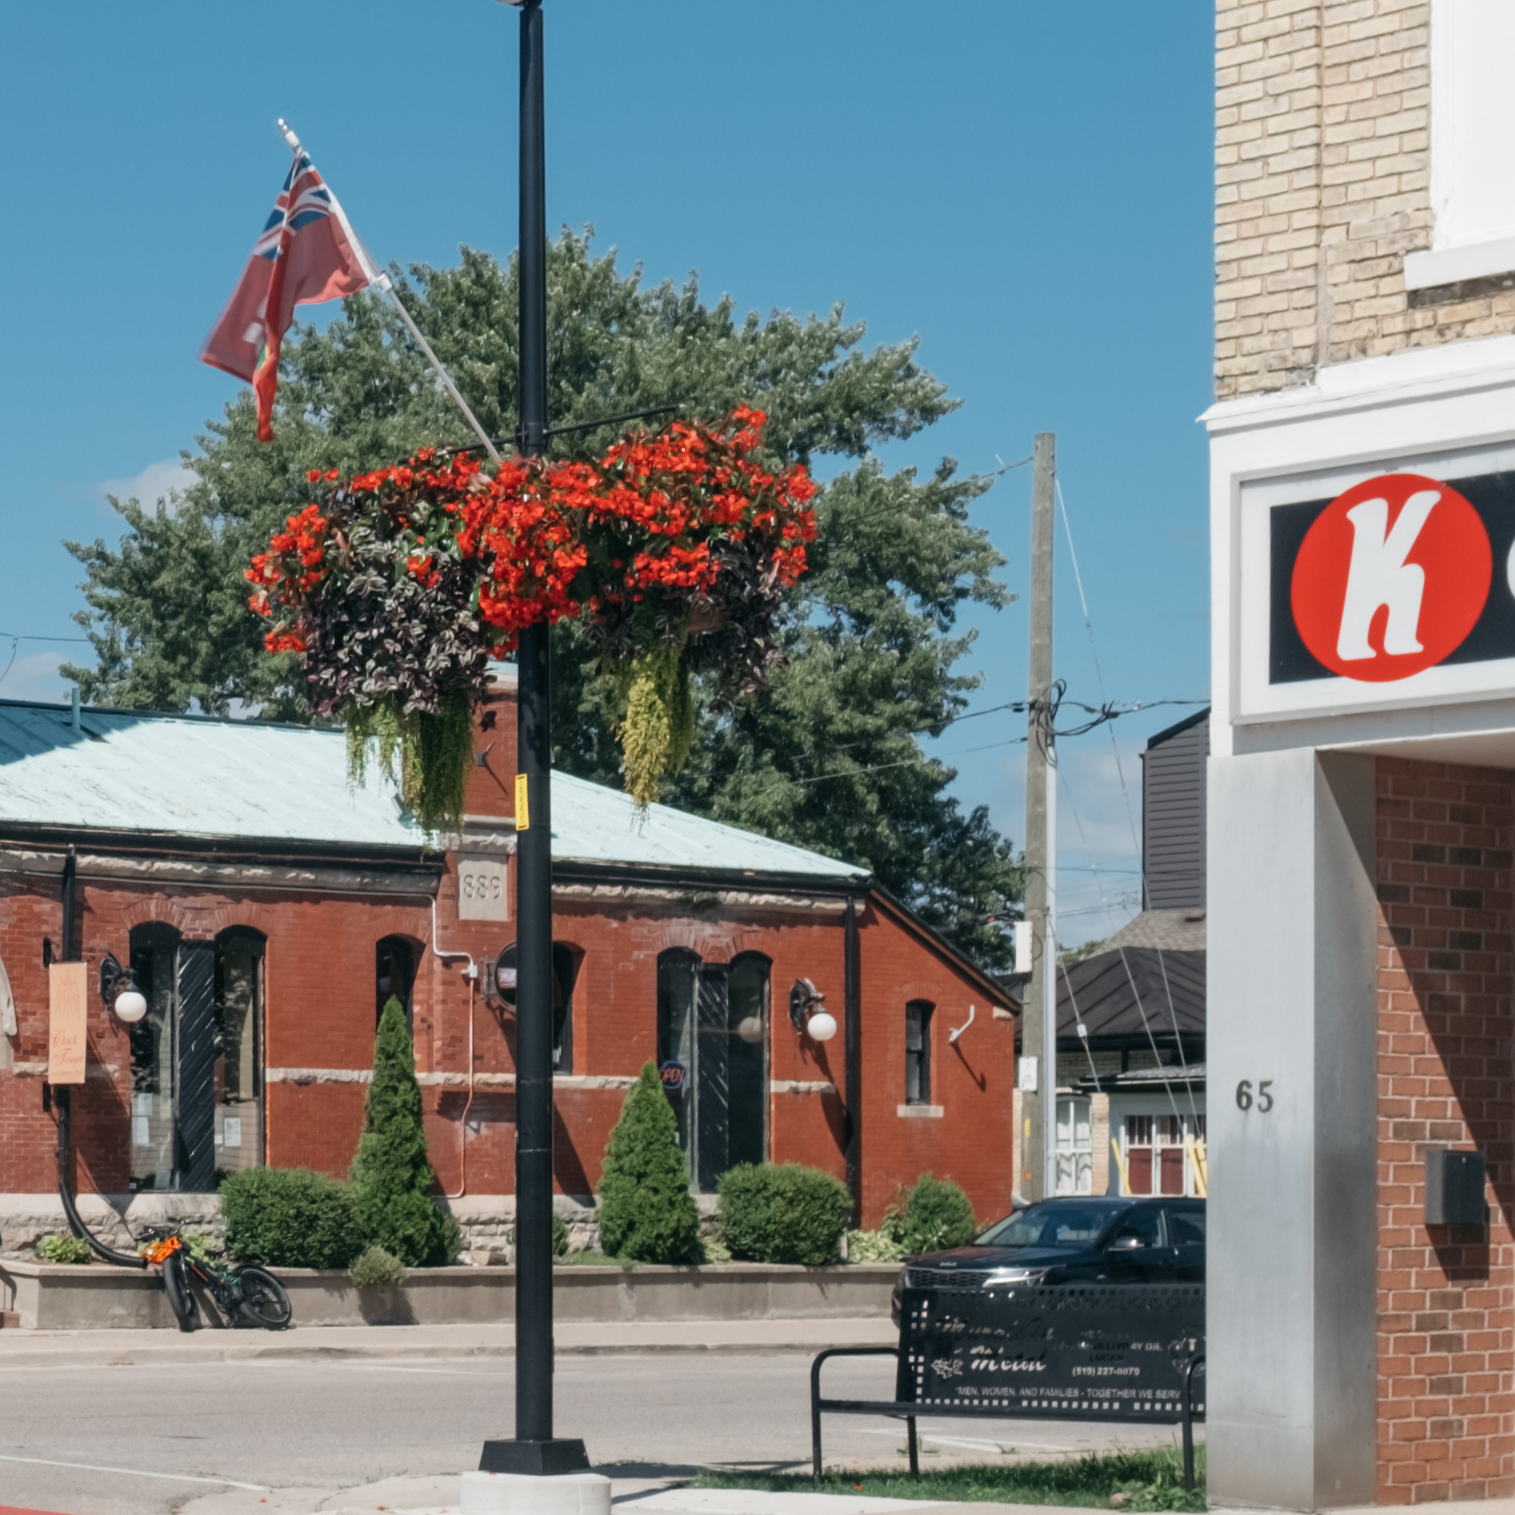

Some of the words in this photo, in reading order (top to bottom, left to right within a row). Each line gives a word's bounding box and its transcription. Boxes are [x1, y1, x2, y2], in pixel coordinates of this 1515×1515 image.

[1337, 490, 1442, 661] K
[1236, 1079, 1274, 1114] 65
[1089, 1354, 1124, 1362] LUCAN
[1072, 1366, 1096, 1377] (519)
[981, 1387, 1017, 1397] WOMEN,
[1019, 1388, 1037, 1397] AND
[1039, 1388, 1079, 1398] FAMILIES
[1087, 1388, 1136, 1398] TOGETHER
[1138, 1389, 1153, 1398] WE
[1155, 1389, 1181, 1399] SERV
